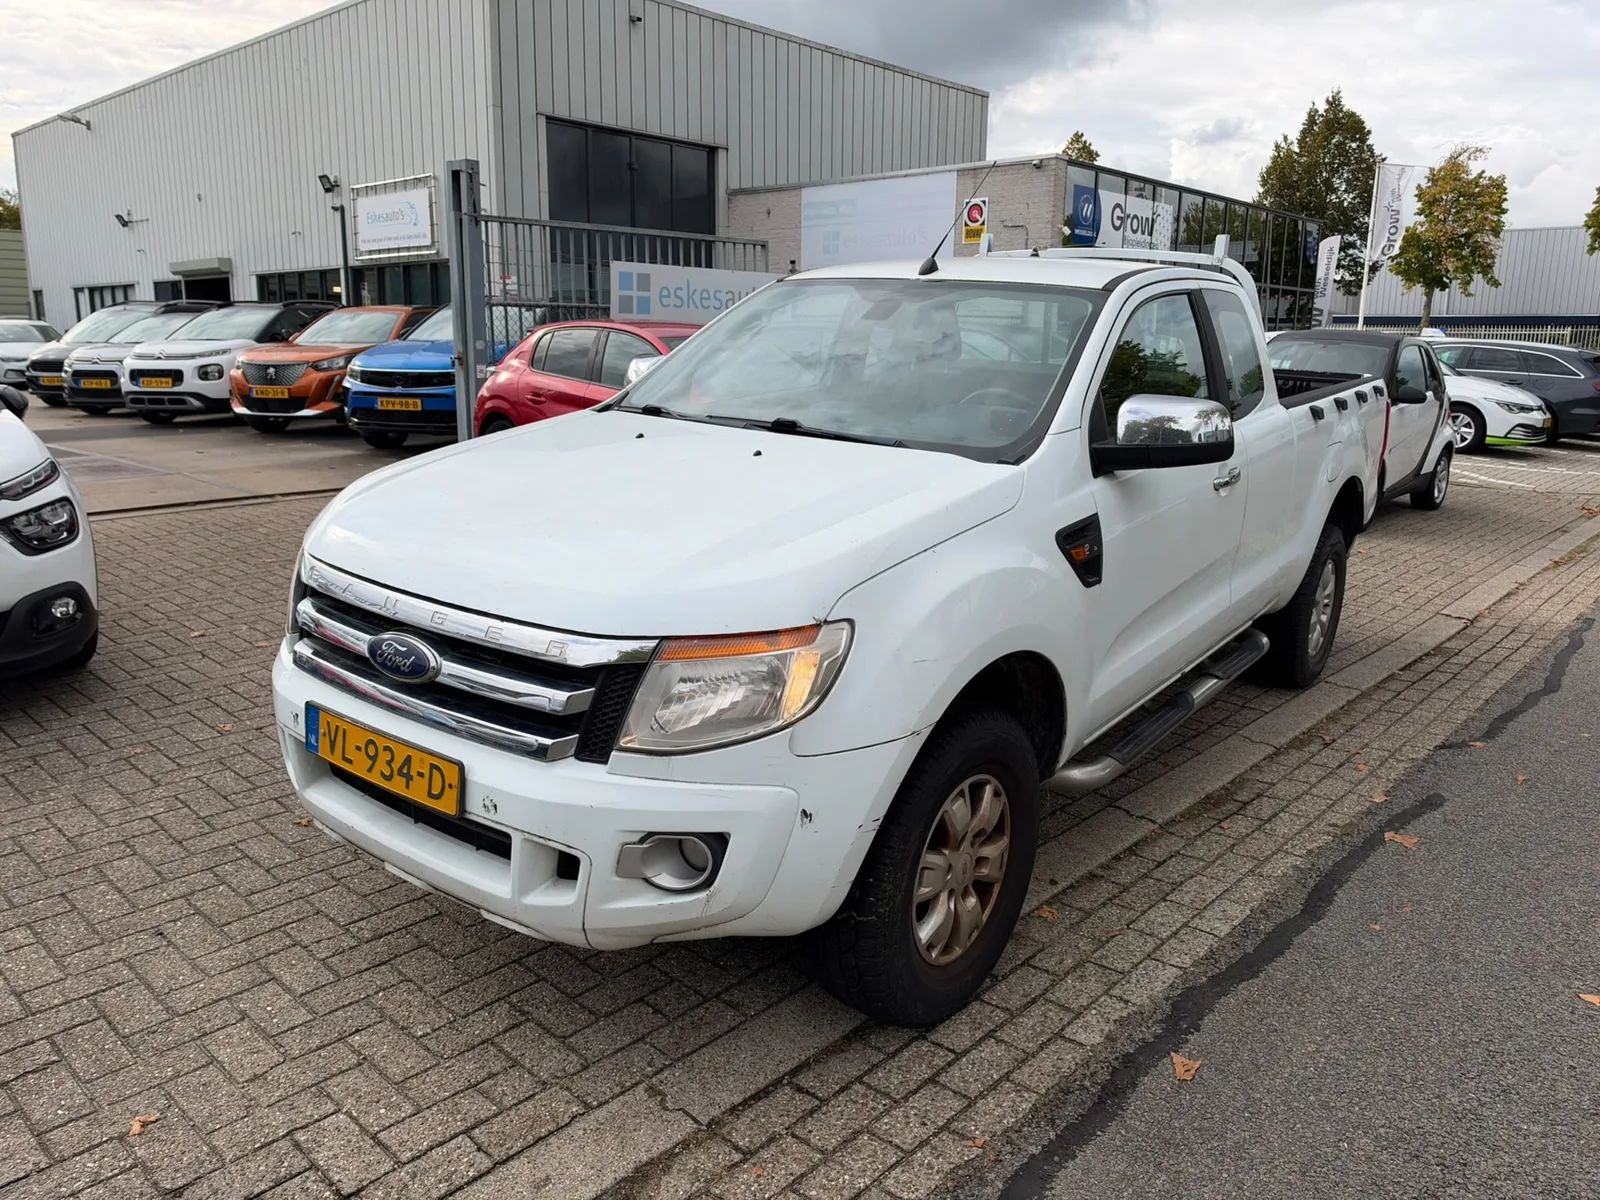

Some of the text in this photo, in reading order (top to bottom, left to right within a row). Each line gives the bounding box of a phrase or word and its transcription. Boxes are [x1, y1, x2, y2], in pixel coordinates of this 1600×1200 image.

[366, 208, 405, 225] Eskesauto's
[1111, 202, 1154, 237] Grow
[1381, 208, 1400, 257] Grow
[1319, 246, 1335, 298] Wesseldijk
[658, 279, 756, 310] eskesa
[254, 388, 287, 398] KND-31-R
[379, 399, 419, 409] KPV-98-B
[378, 639, 413, 673] Ford
[308, 732, 318, 746] NL
[326, 719, 446, 801] VL-934-D
